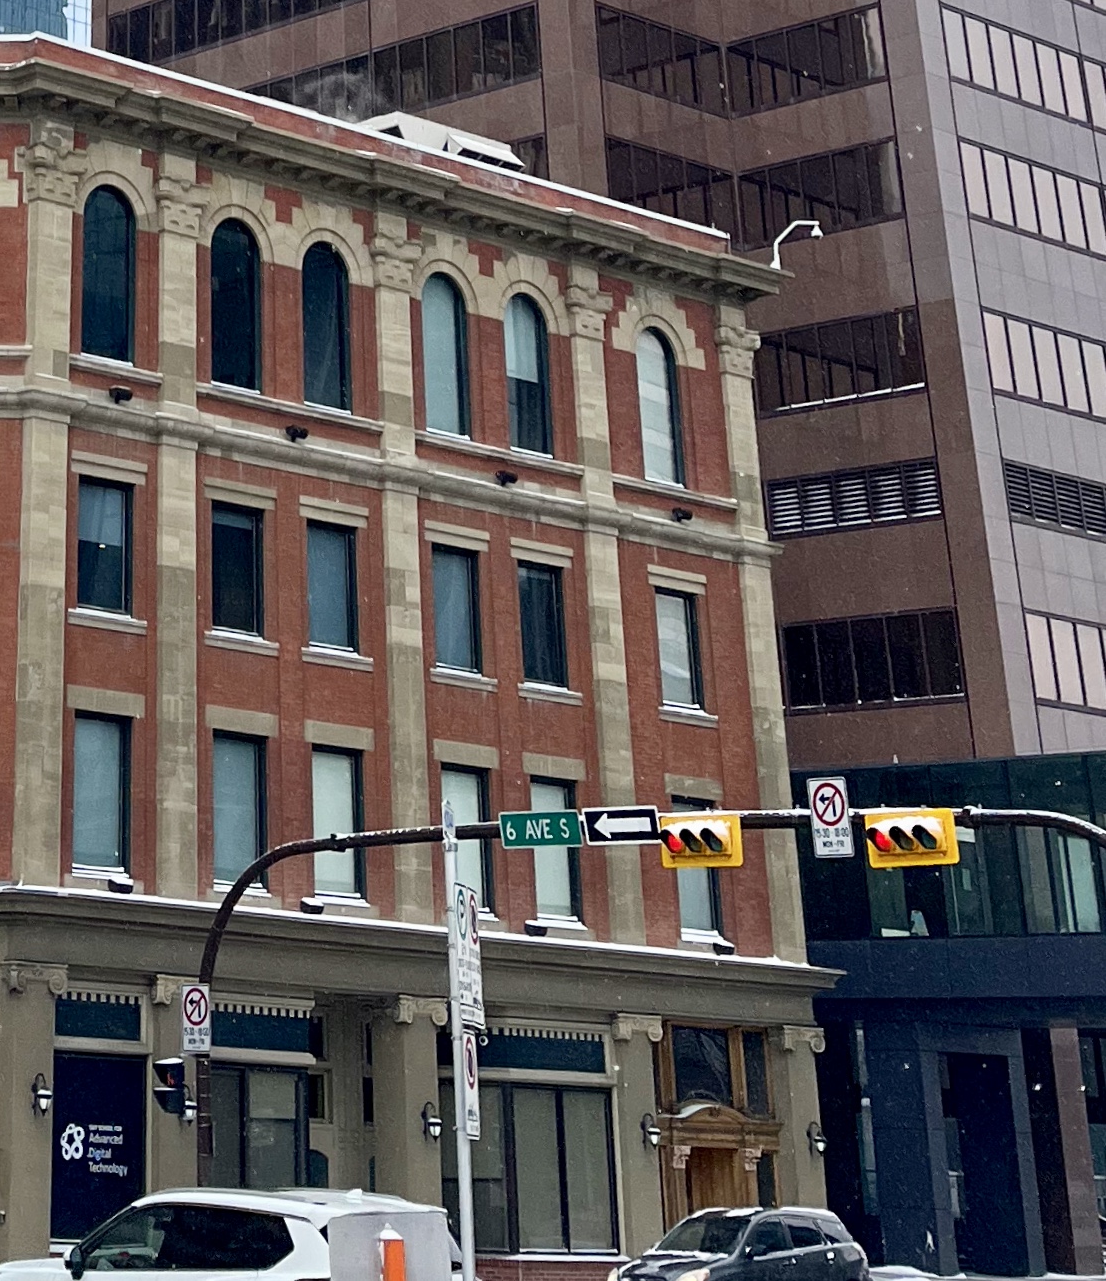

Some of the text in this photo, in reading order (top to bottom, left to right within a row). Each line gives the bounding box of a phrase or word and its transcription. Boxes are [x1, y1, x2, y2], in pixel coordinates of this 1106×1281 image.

[506, 818, 570, 840] 6 AVE S
[89, 1132, 123, 1145] Advanced
[88, 1147, 112, 1161] Digital
[88, 1161, 128, 1177] Technology
